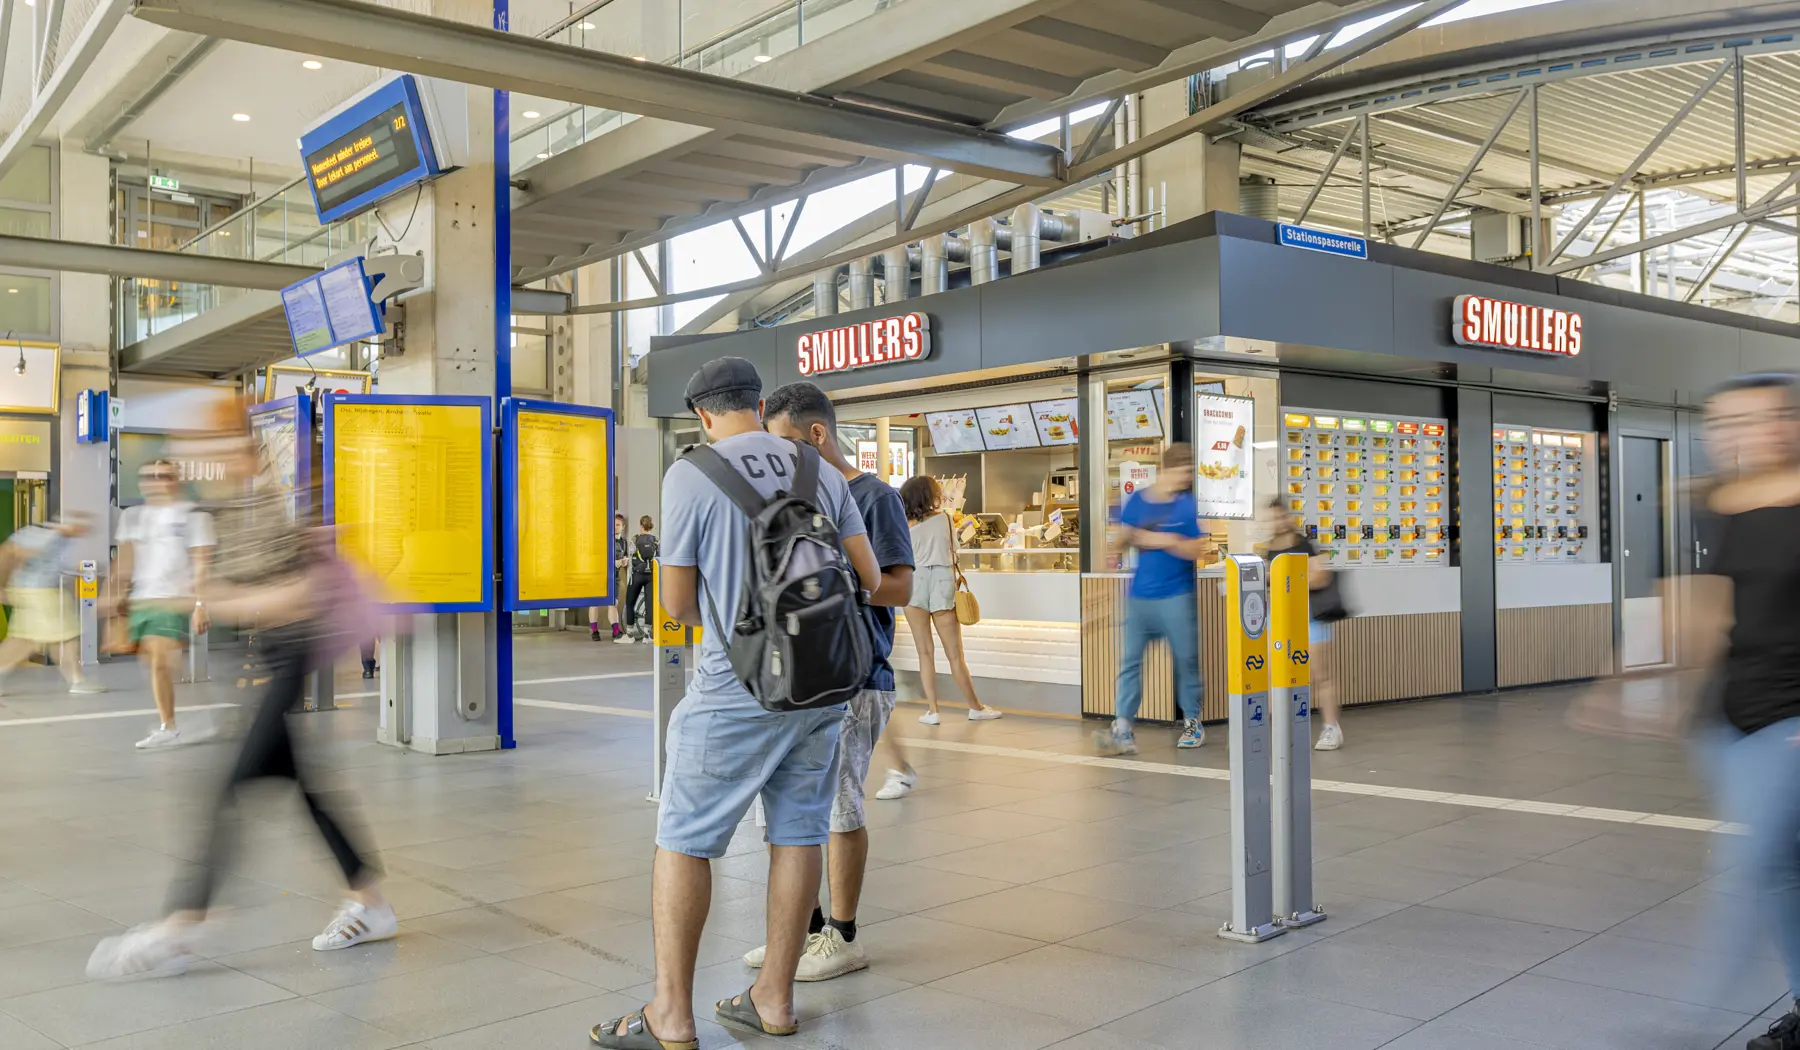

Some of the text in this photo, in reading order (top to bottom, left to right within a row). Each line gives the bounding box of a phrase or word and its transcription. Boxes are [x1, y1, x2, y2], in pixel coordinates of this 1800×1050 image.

[393, 116, 406, 130] 2/2
[312, 136, 373, 175] Momenteel minder treinen
[316, 176, 328, 189] Door
[328, 165, 344, 182] tekort
[344, 163, 354, 174] aan
[1286, 228, 1361, 252] Stationspasserelle
[1464, 296, 1581, 356] SMULLERS
[798, 313, 922, 375] SMULLERS
[0, 434, 40, 444] ENTEN
